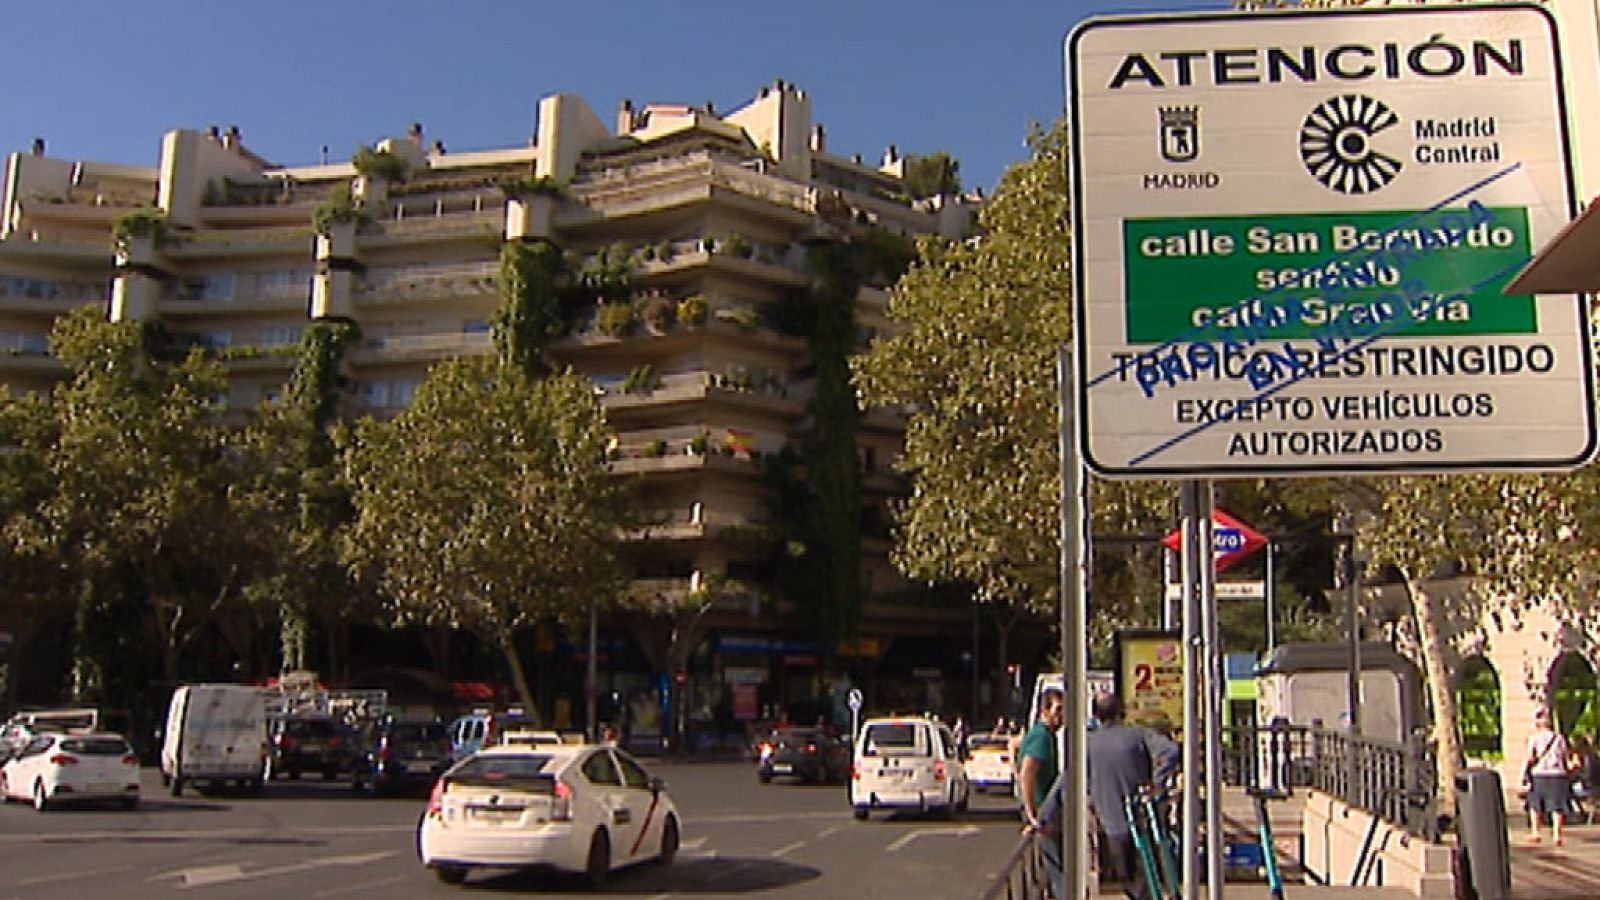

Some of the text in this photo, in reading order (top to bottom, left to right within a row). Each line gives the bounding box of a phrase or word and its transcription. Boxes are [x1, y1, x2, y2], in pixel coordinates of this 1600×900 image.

[1109, 33, 1524, 89] ATENCIÓN
[1415, 117, 1496, 140] Madrid
[1415, 142, 1500, 165] Central
[1143, 172, 1220, 190] MADRID
[1141, 223, 1514, 257] calle San Bernardo
[1256, 261, 1400, 290] sentido
[1301, 297, 1395, 325] Gran
[1111, 344, 1554, 382] TRÁFICO RESTRINGIDO
[1177, 392, 1494, 424] EXCEPTO VEHÍCULOS
[1228, 429, 1443, 457] AUTORIZADOS
[1135, 663, 1152, 691] 2
